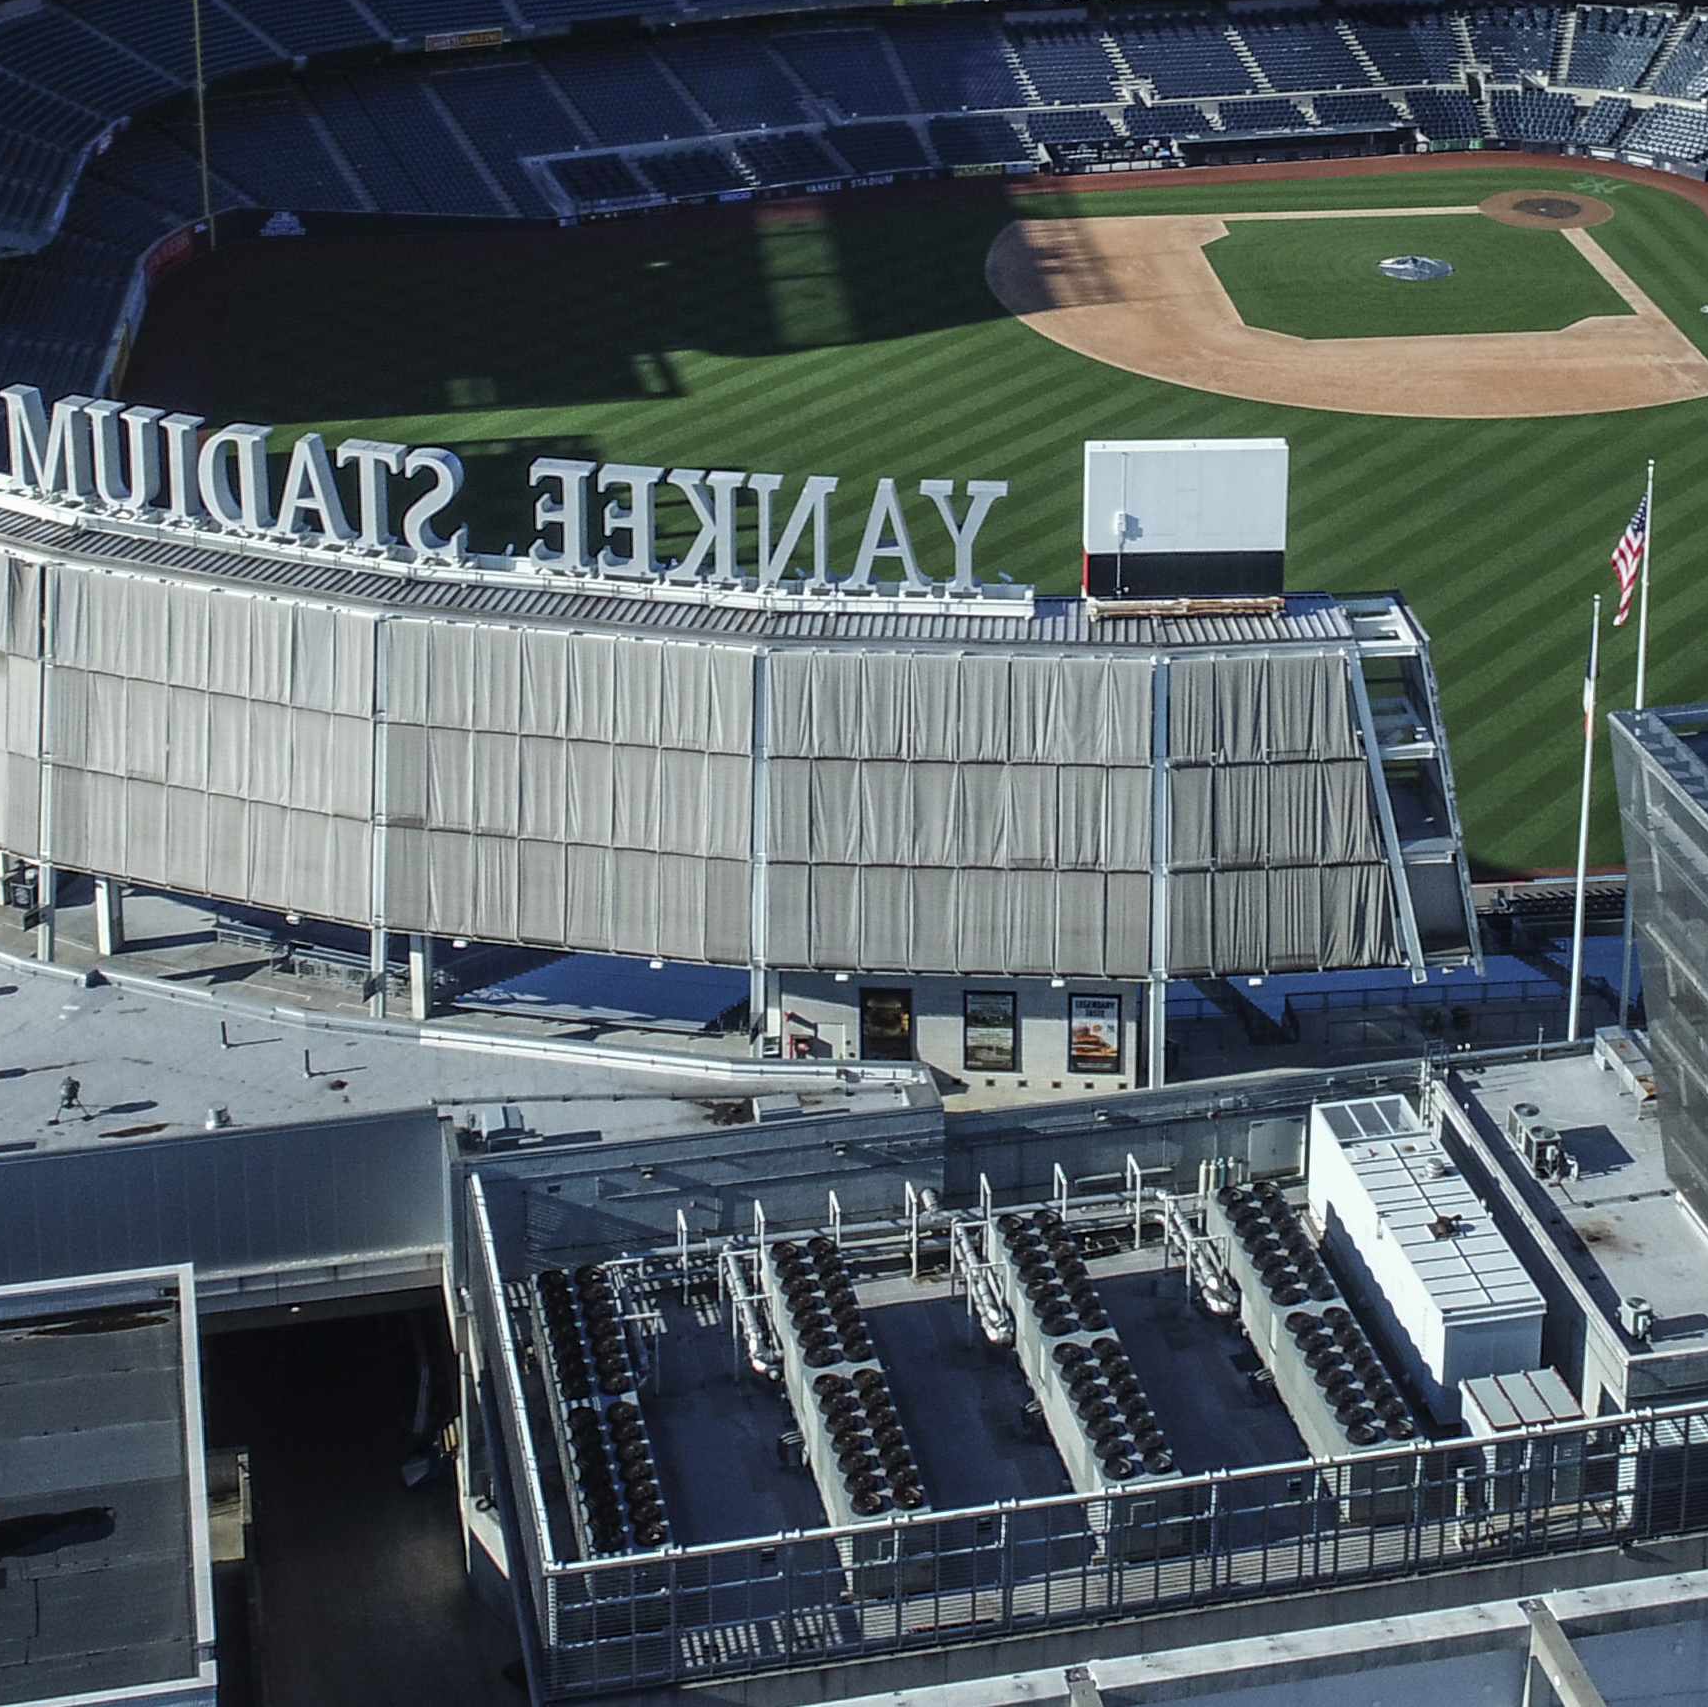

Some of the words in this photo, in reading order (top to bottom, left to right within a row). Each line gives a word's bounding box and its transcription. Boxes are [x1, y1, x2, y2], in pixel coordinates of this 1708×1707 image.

[805, 181, 842, 193] YANKEE
[850, 175, 894, 188] STADIUM
[1076, 1001, 1114, 1009] LEGENDARY
